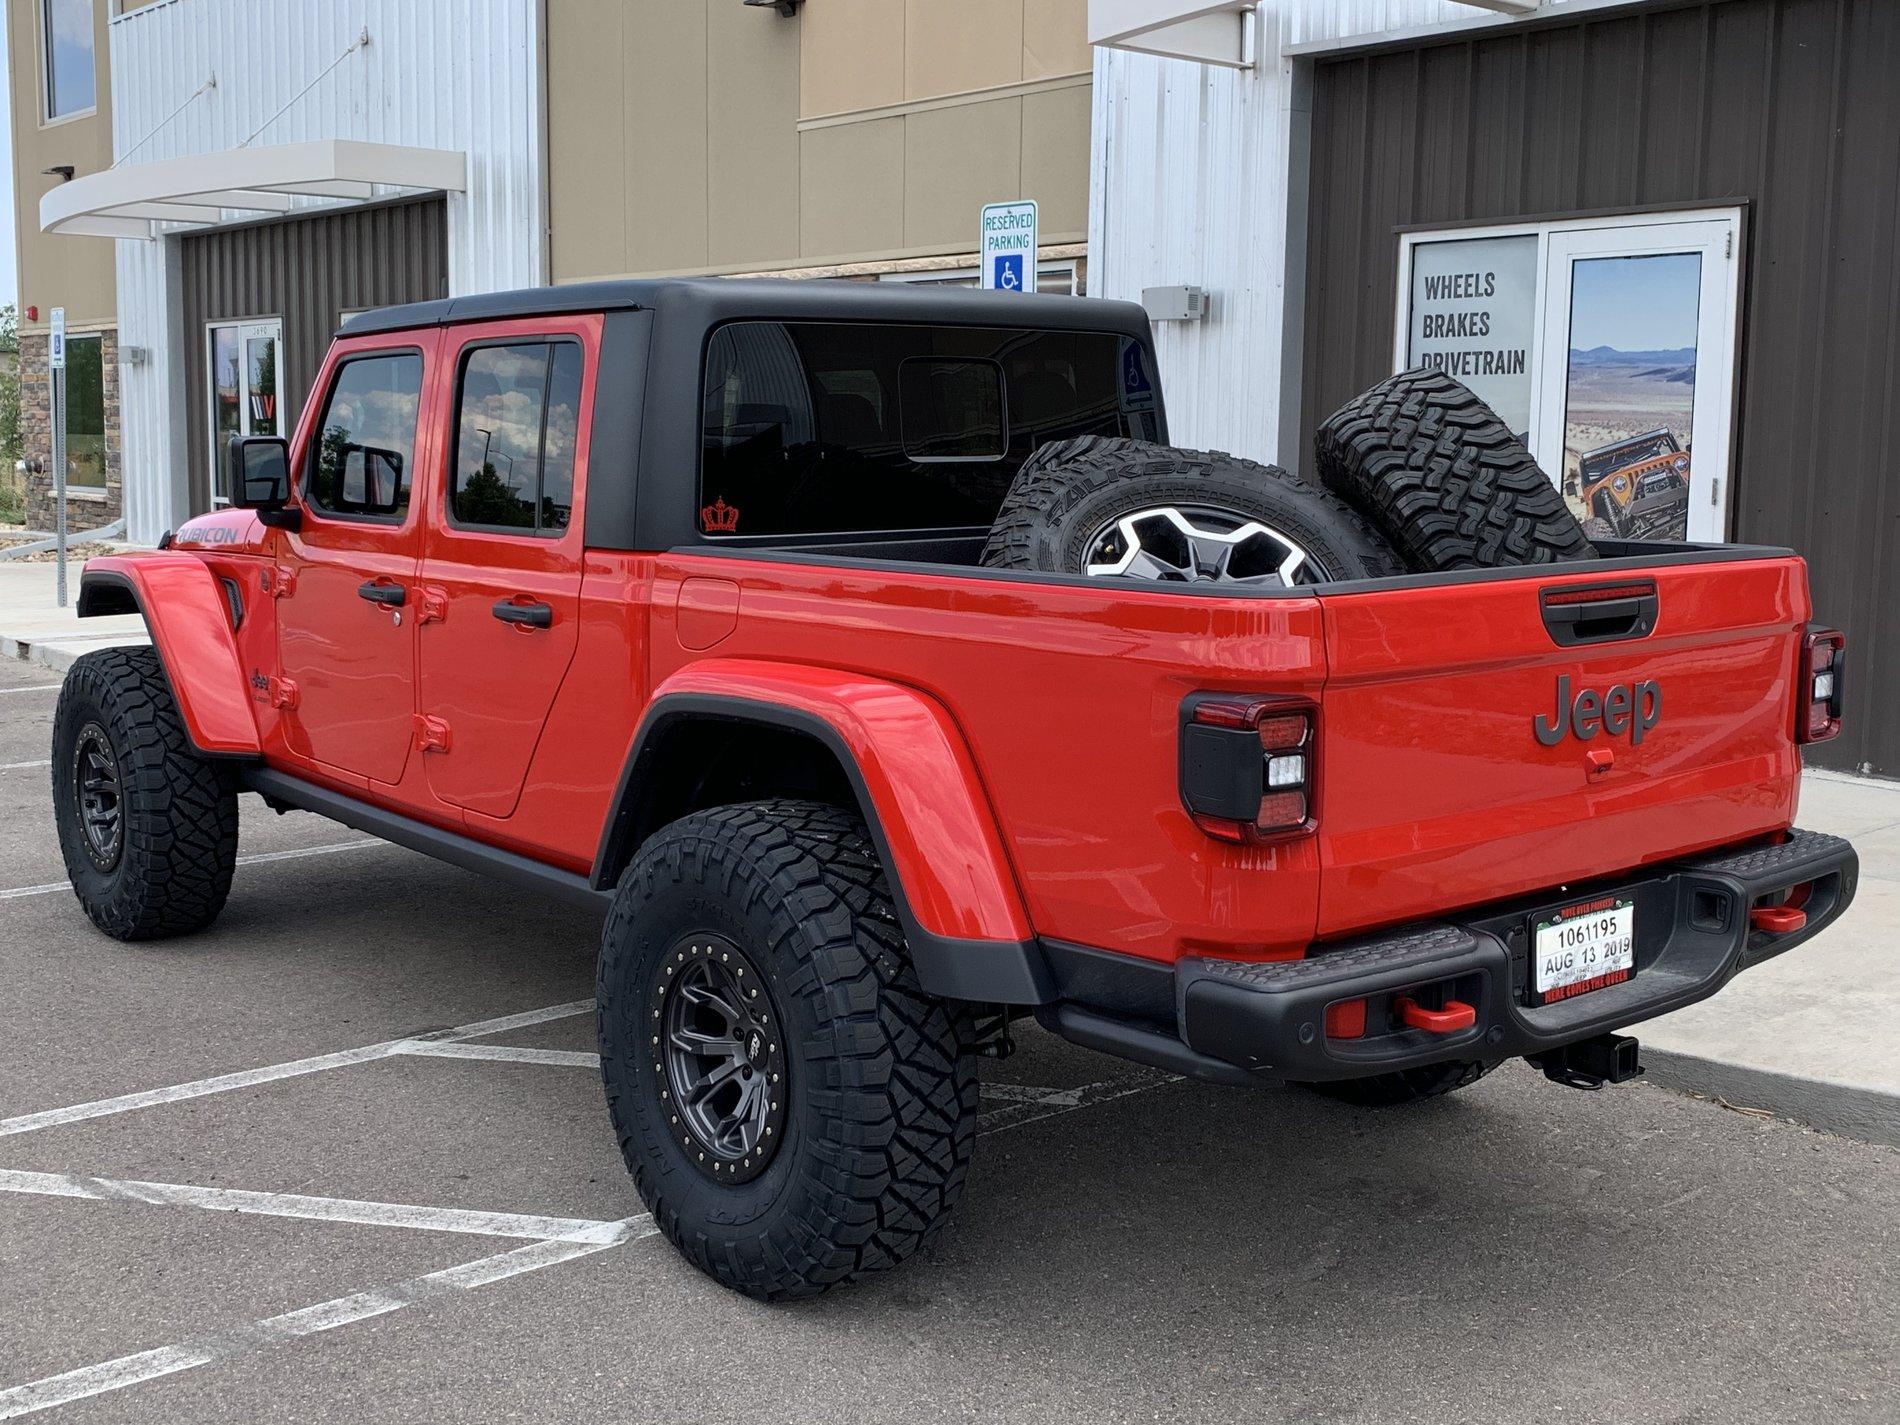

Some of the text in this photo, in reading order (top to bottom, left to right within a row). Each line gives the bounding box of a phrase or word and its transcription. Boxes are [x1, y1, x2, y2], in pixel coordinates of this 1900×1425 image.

[985, 214, 1032, 231] RESERVED
[988, 234, 1029, 250] PARKING
[1424, 272, 1496, 301] WHEELS
[1422, 311, 1491, 339] BRAKES
[1421, 349, 1526, 376] DRIVETRAIN
[177, 527, 239, 544] RUBICON
[1534, 673, 1662, 746] Jeep
[1558, 916, 1617, 948] 1061195
[1545, 952, 1573, 975] AUG
[1582, 946, 1596, 964] 13
[1604, 937, 1631, 959] 2019
[1545, 987, 1565, 1003] HERE
[1566, 981, 1590, 997] COMES
[1591, 976, 1604, 990] THE
[1605, 970, 1628, 985] QUEEN
